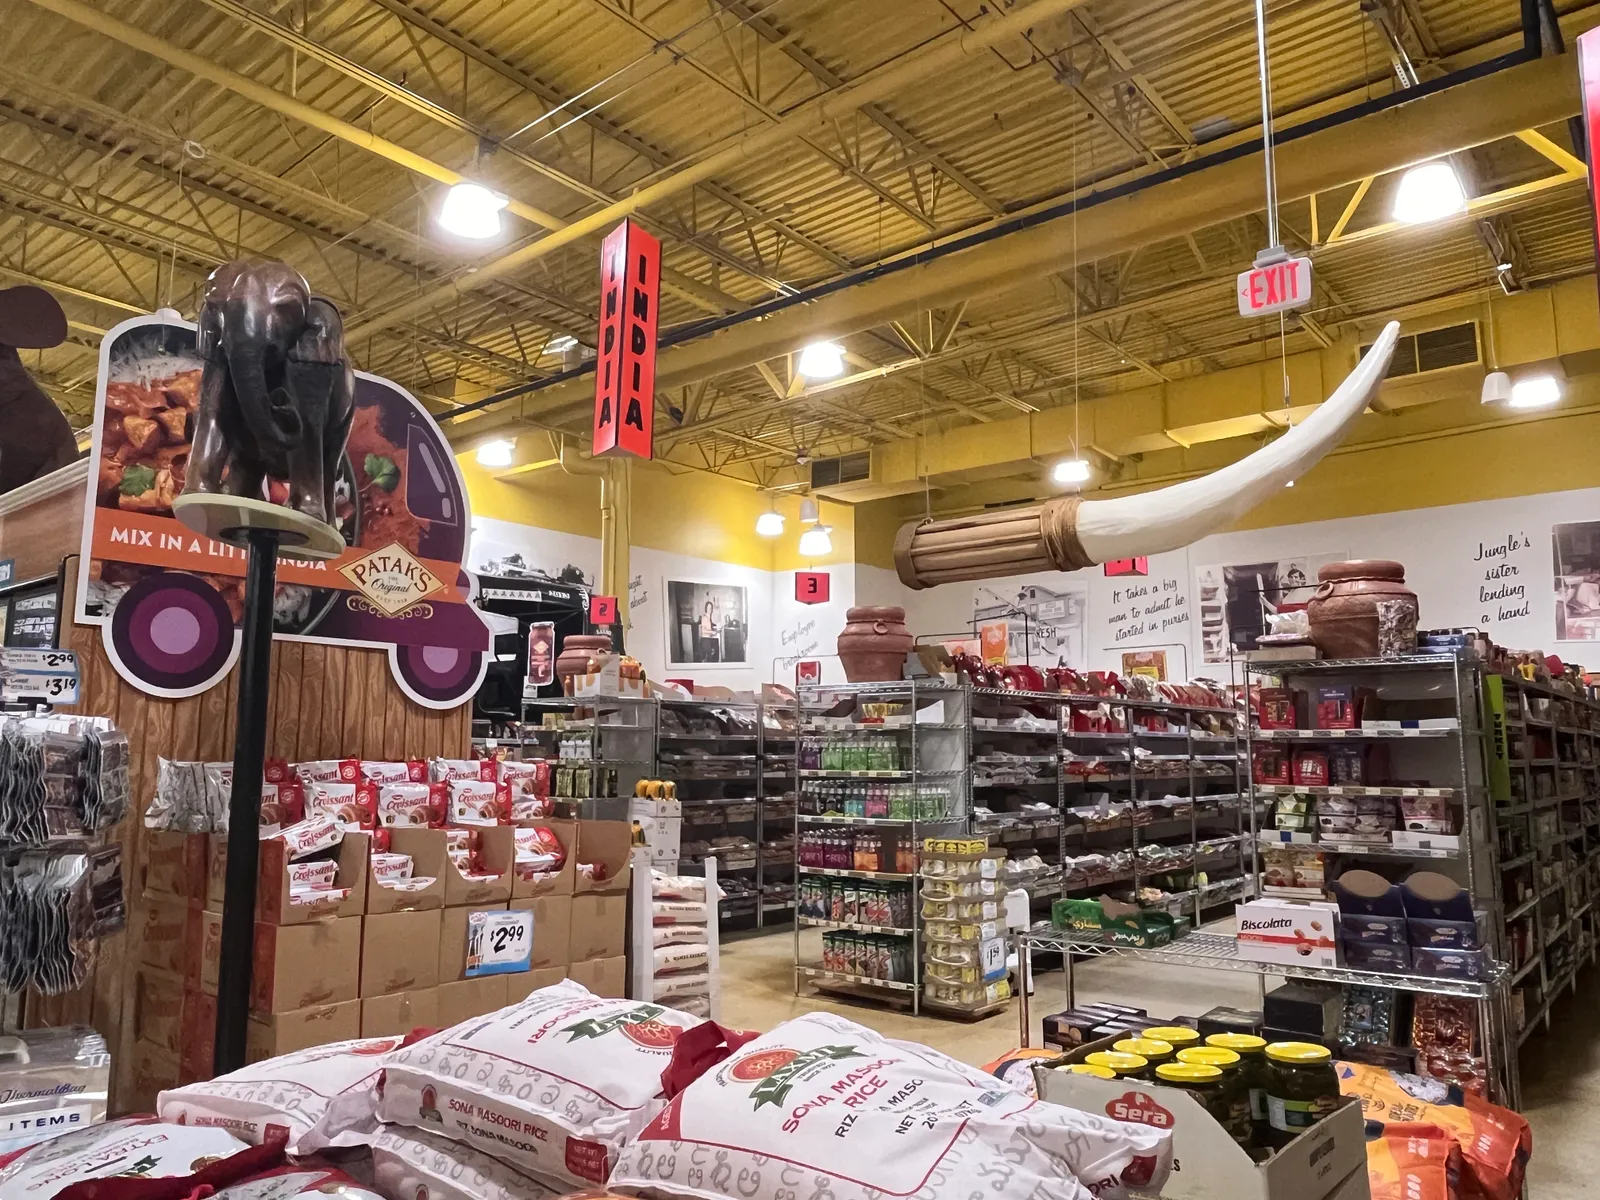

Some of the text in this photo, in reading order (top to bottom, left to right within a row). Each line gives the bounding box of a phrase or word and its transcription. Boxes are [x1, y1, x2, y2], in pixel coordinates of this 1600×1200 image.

[1249, 262, 1299, 309] EXIT
[599, 252, 617, 429] INDIA
[625, 254, 649, 431] INDIA
[110, 526, 153, 547] MIX
[160, 533, 183, 551] IN
[188, 538, 202, 554] A
[1473, 531, 1531, 561] Jungle's
[351, 556, 432, 592] PATAK'S
[1485, 564, 1519, 580] sister
[371, 578, 412, 595] Original
[807, 577, 817, 593] 3
[1113, 578, 1178, 604] It takes a big
[1479, 583, 1525, 603] lending
[1109, 613, 1127, 624] man
[1131, 606, 1141, 619] to
[1144, 597, 1172, 615] admit
[1481, 600, 1530, 623] a hand
[1115, 612, 1190, 641] started in purses
[313, 793, 354, 807] Croissant
[387, 795, 427, 810] Croissant
[458, 791, 494, 803] Croissant
[293, 862, 335, 882] Croissant
[1241, 917, 1293, 931] Biscolata
[755, 1047, 837, 1094] LAXMI
[843, 1074, 888, 1108] RICE
[9, 1113, 80, 1131] ITEMS
[448, 1098, 475, 1117] SONA
[524, 1122, 548, 1142] RICE
[782, 1093, 834, 1134] SONA
[835, 1113, 858, 1138] RIZ
[895, 1114, 917, 1135] NET
[1114, 1102, 1167, 1126] Sera
